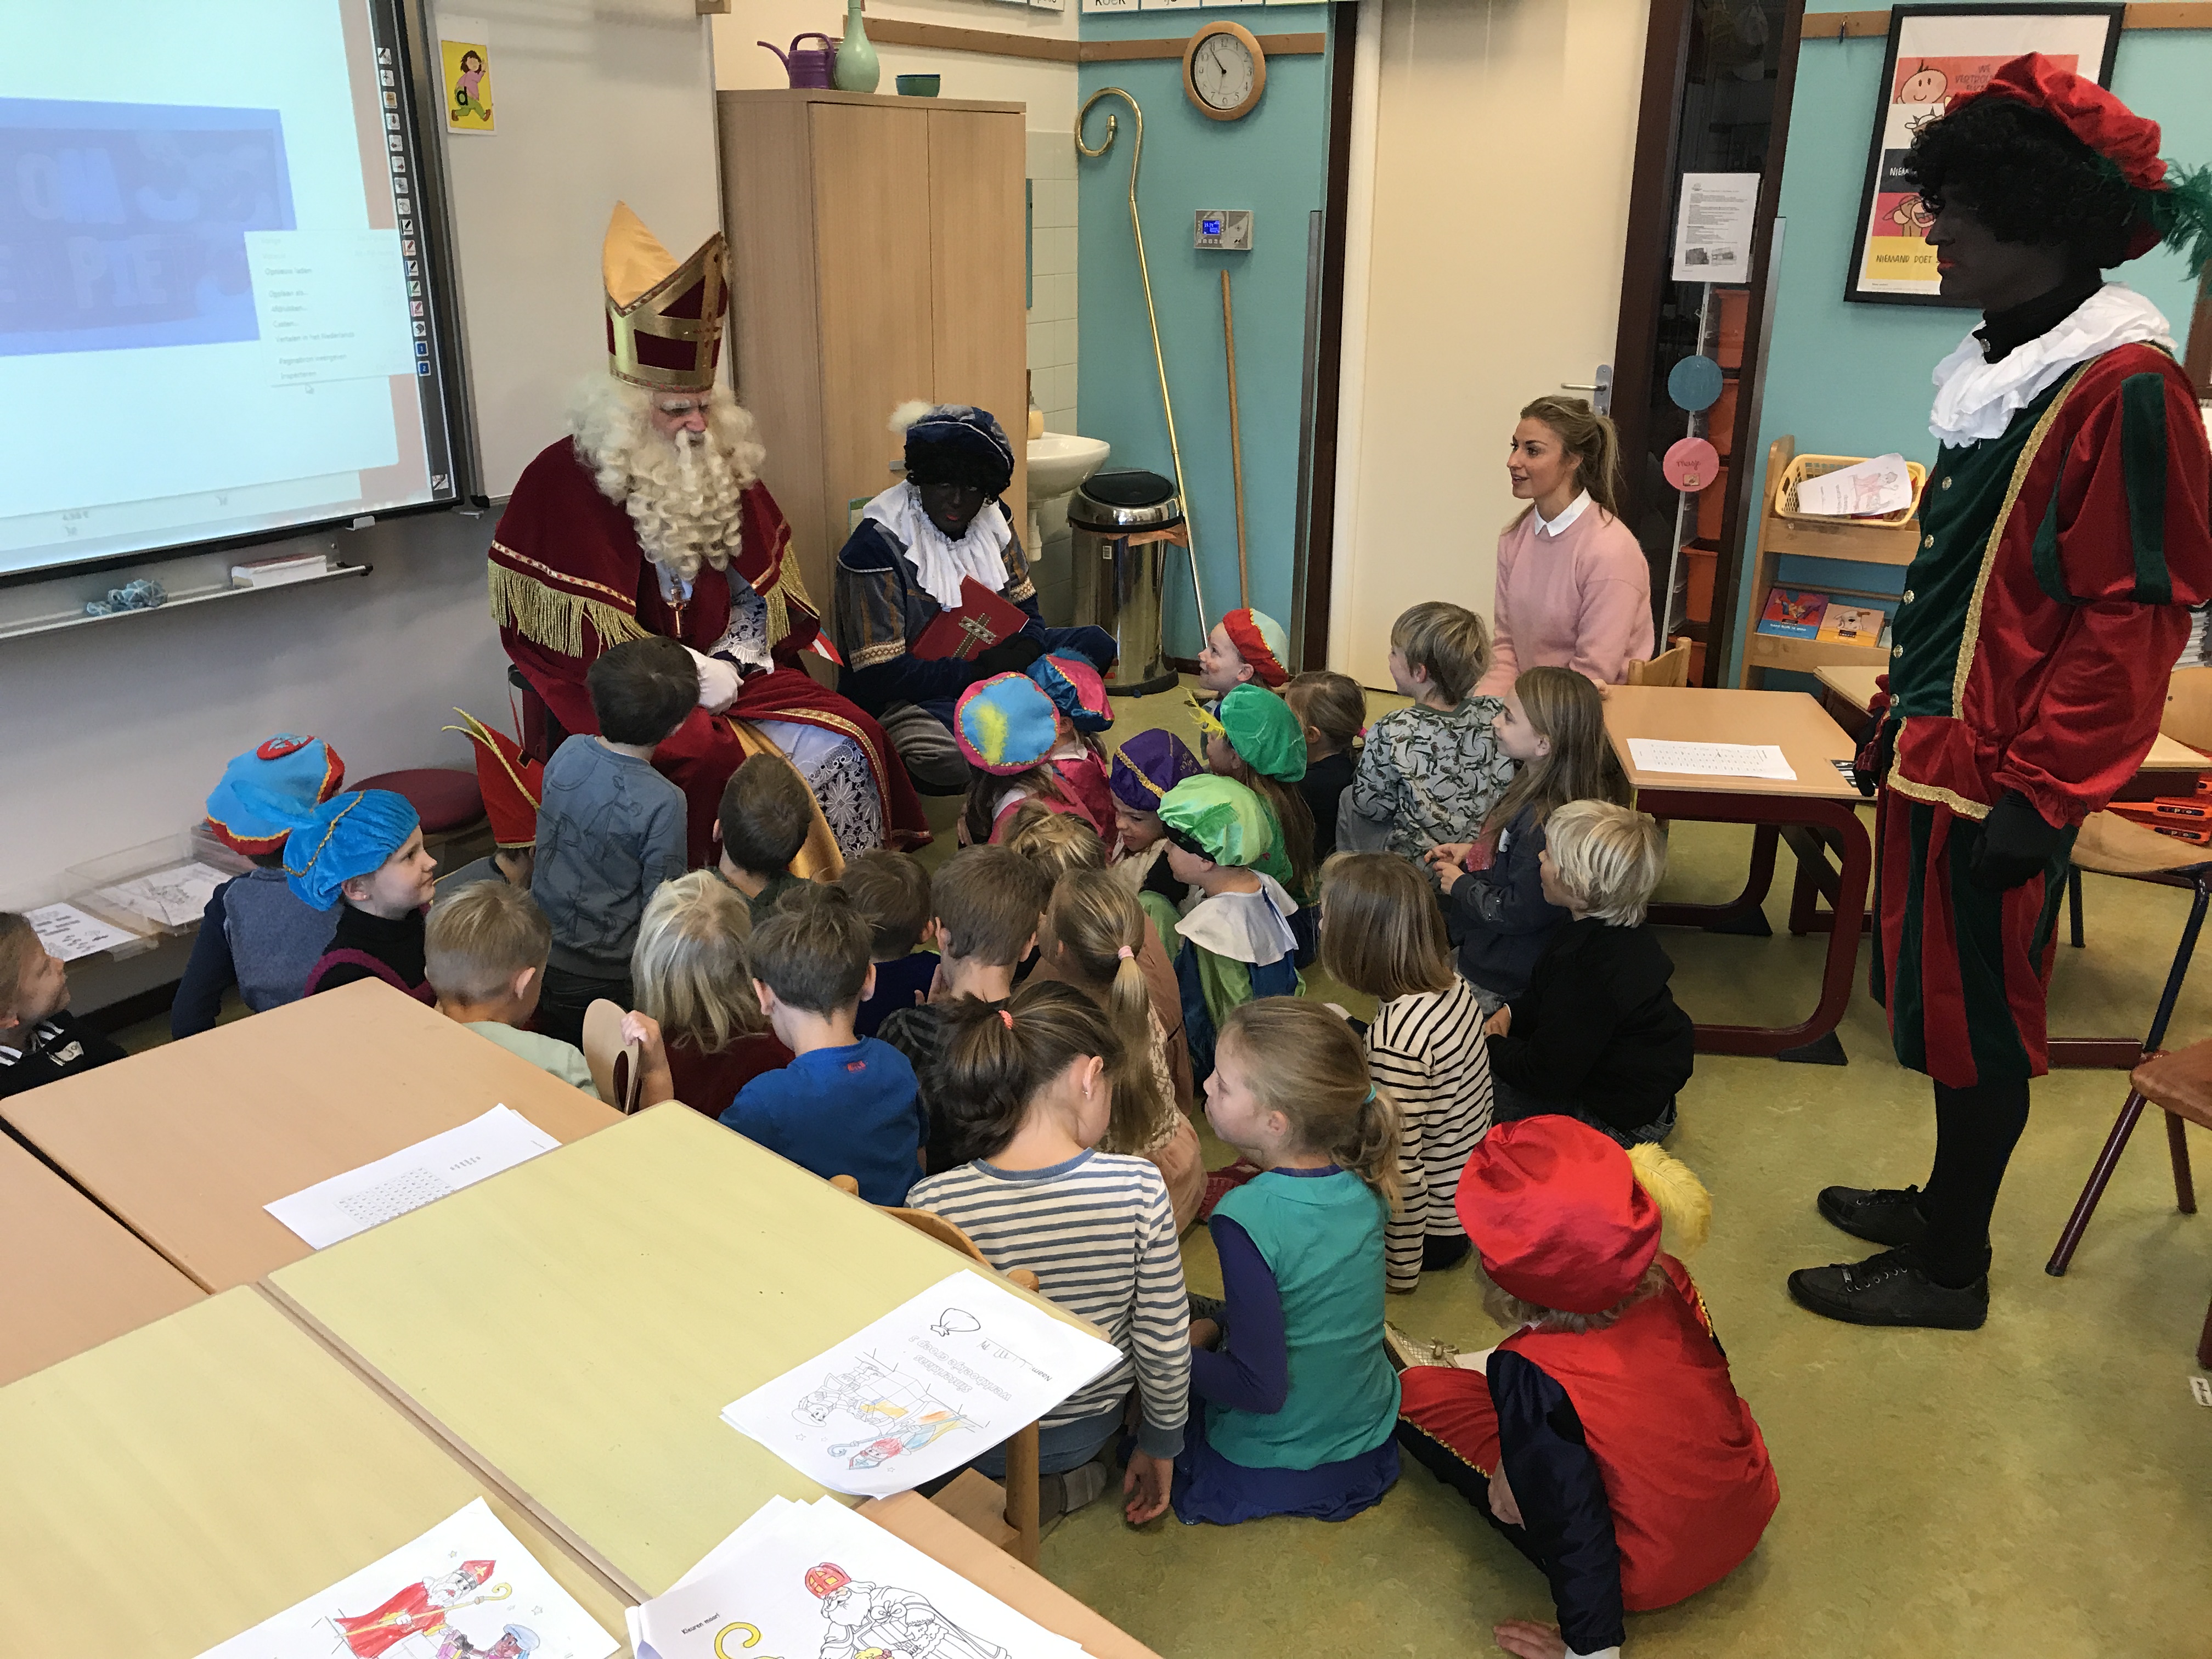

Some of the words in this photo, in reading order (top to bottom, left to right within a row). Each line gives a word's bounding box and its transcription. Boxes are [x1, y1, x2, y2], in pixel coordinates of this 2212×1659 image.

[456, 86, 469, 106] d
[1876, 255, 1910, 263] NIEMAND
[1914, 255, 1932, 263] DOET
[913, 1355, 973, 1393] sinterklaas
[947, 1359, 1012, 1401] werkboekje
[681, 1622, 704, 1634] Kleuren
